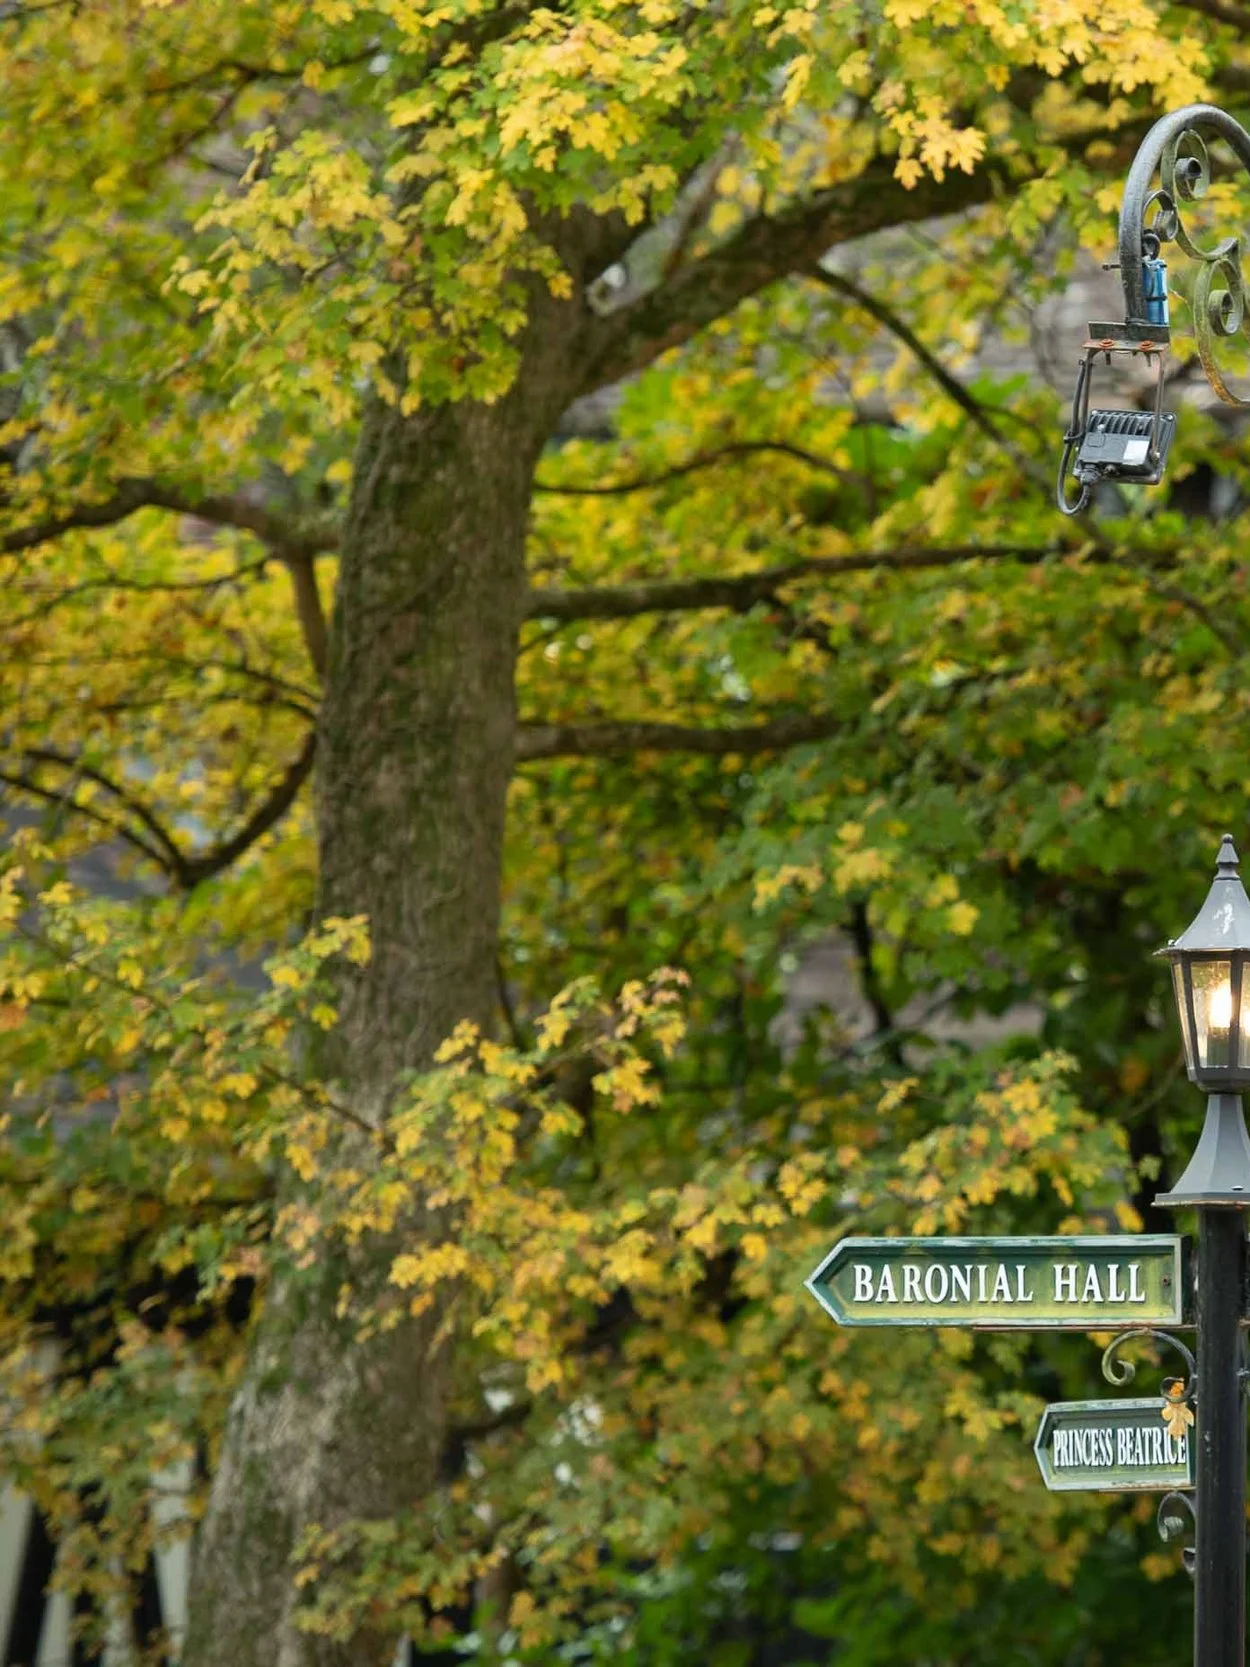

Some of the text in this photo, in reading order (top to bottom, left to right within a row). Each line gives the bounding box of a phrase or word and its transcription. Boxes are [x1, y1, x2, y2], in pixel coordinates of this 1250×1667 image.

[852, 1264, 1146, 1302] BARONIAL HALL
[1053, 1428, 1114, 1467] PRINCESS
